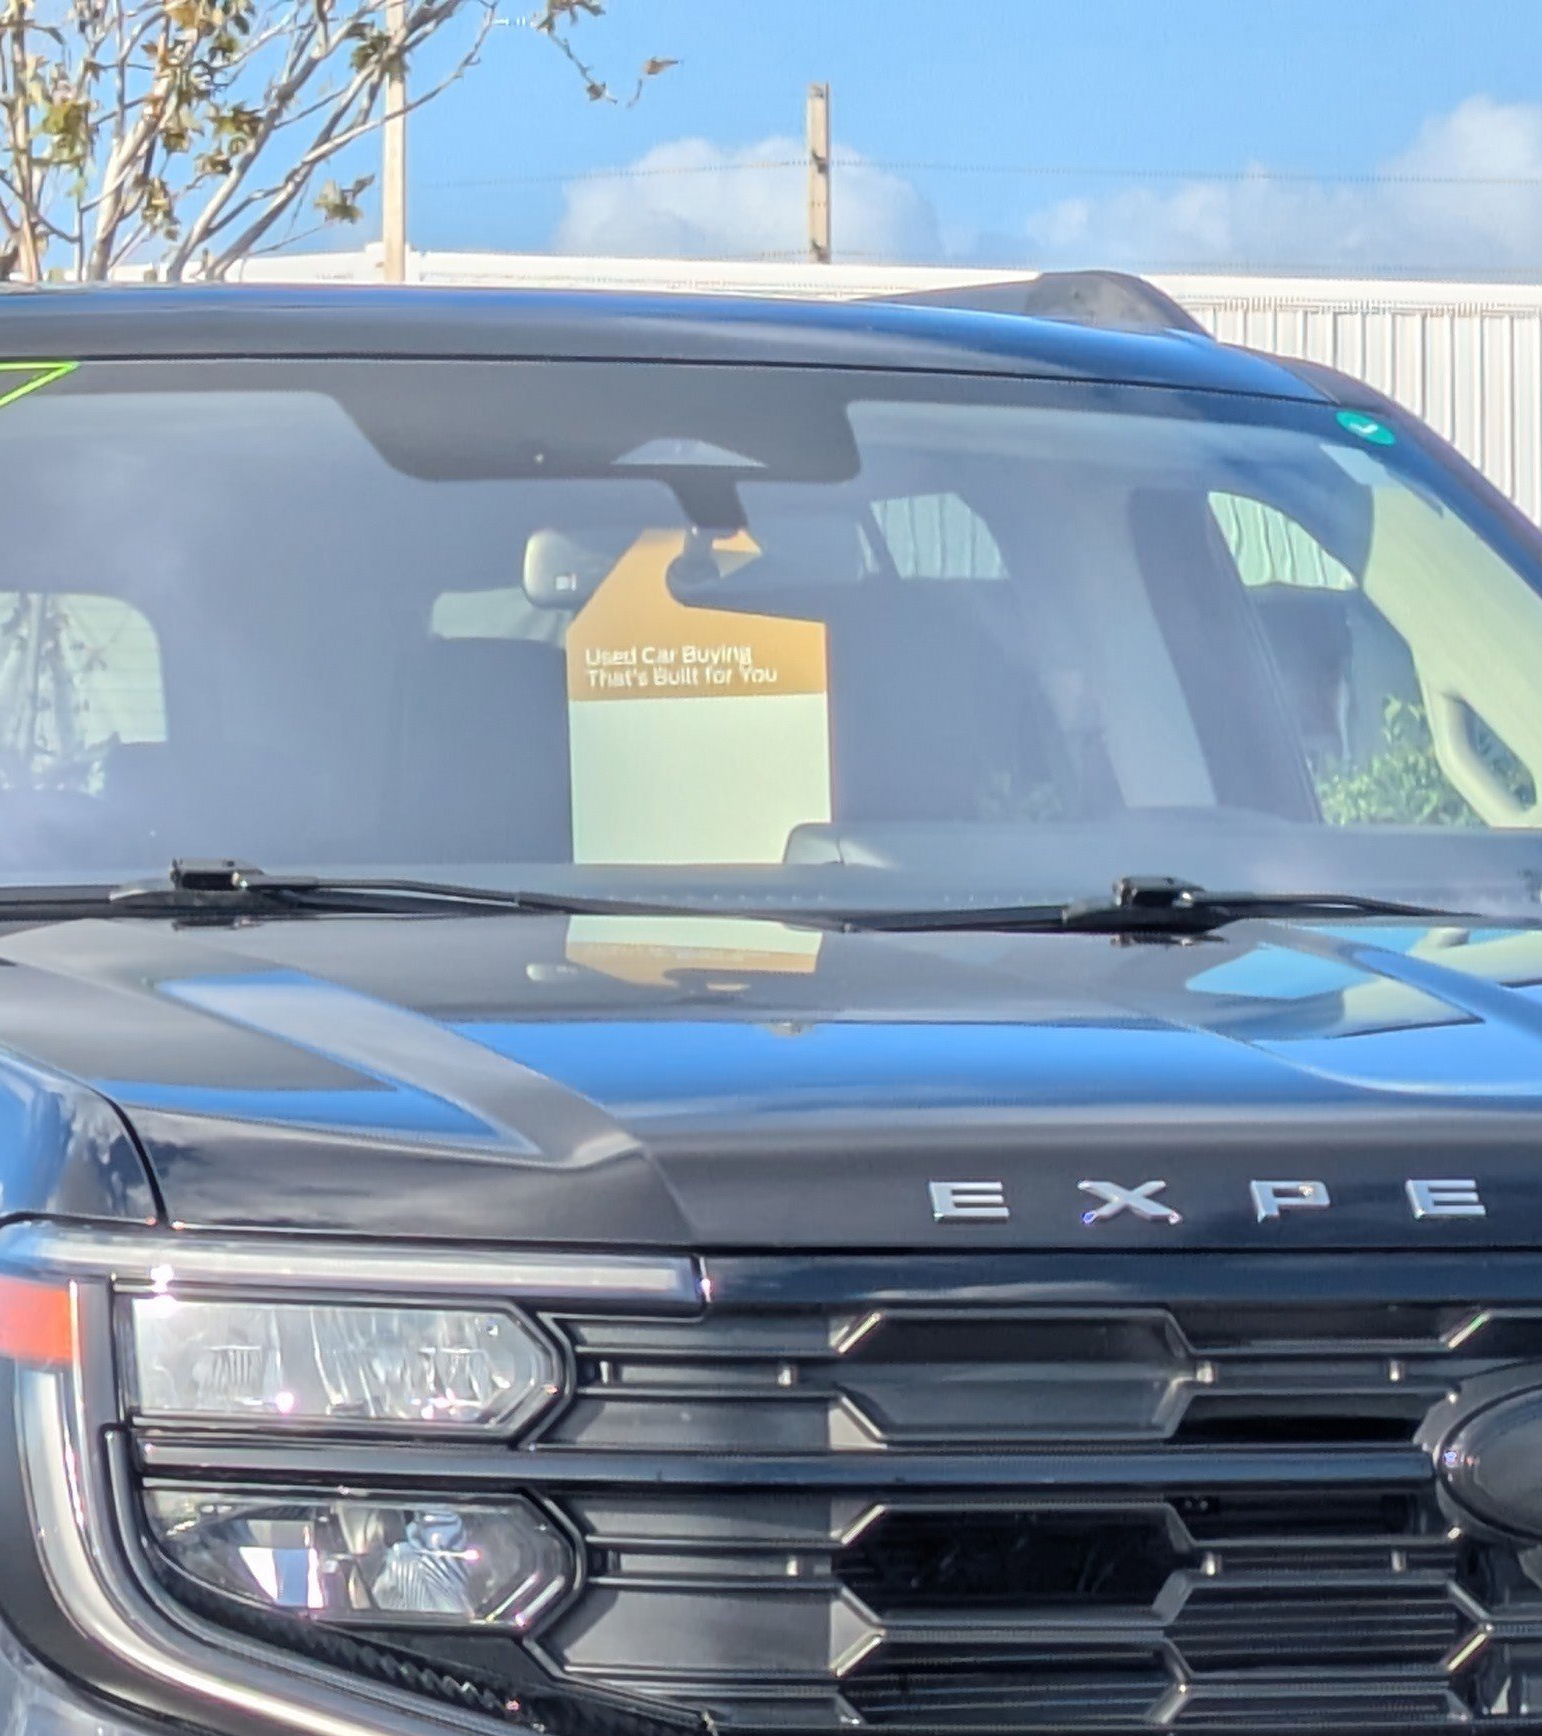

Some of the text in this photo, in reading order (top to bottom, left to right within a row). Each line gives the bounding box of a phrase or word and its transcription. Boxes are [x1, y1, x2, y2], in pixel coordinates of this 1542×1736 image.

[585, 644, 753, 671] Used Car Buying
[588, 667, 778, 688] That's Built for You
